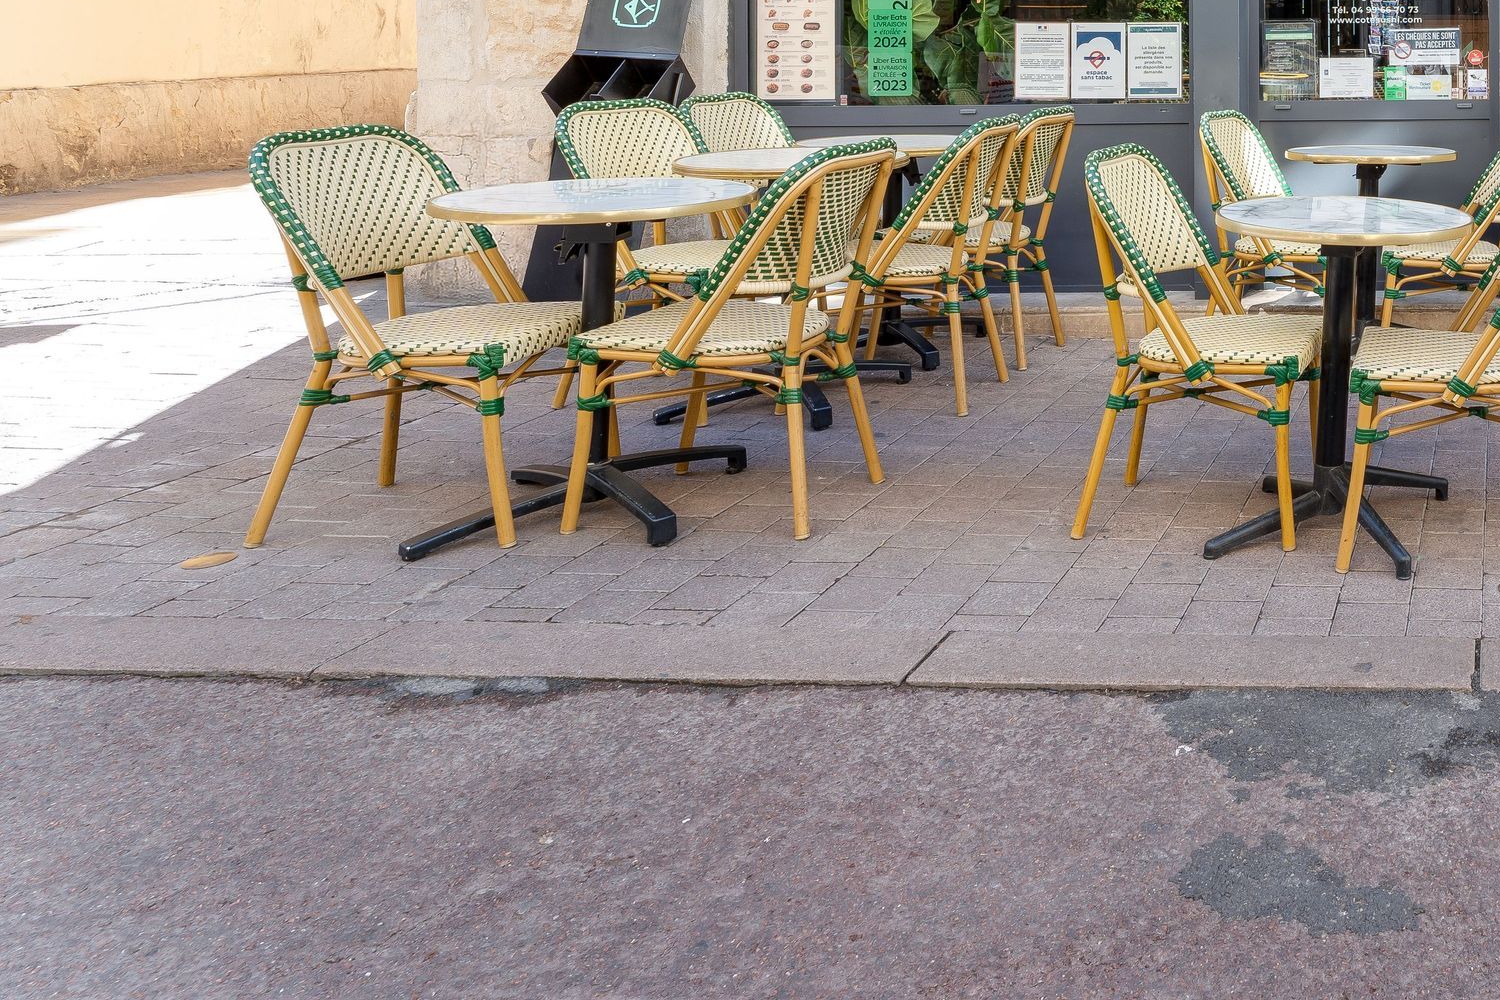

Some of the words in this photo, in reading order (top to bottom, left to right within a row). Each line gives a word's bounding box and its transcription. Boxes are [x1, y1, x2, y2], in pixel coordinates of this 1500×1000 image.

[1332, 6, 1349, 14] Tél.
[1408, 6, 1419, 14] 73
[1405, 31, 1432, 40] CHÈQUES
[1432, 32, 1440, 40] NE
[1441, 32, 1456, 40] SONT
[873, 37, 907, 48] 2024
[1415, 41, 1426, 49] PAS
[1427, 40, 1456, 49] ACCEPTÉS
[873, 80, 907, 91] 2023
